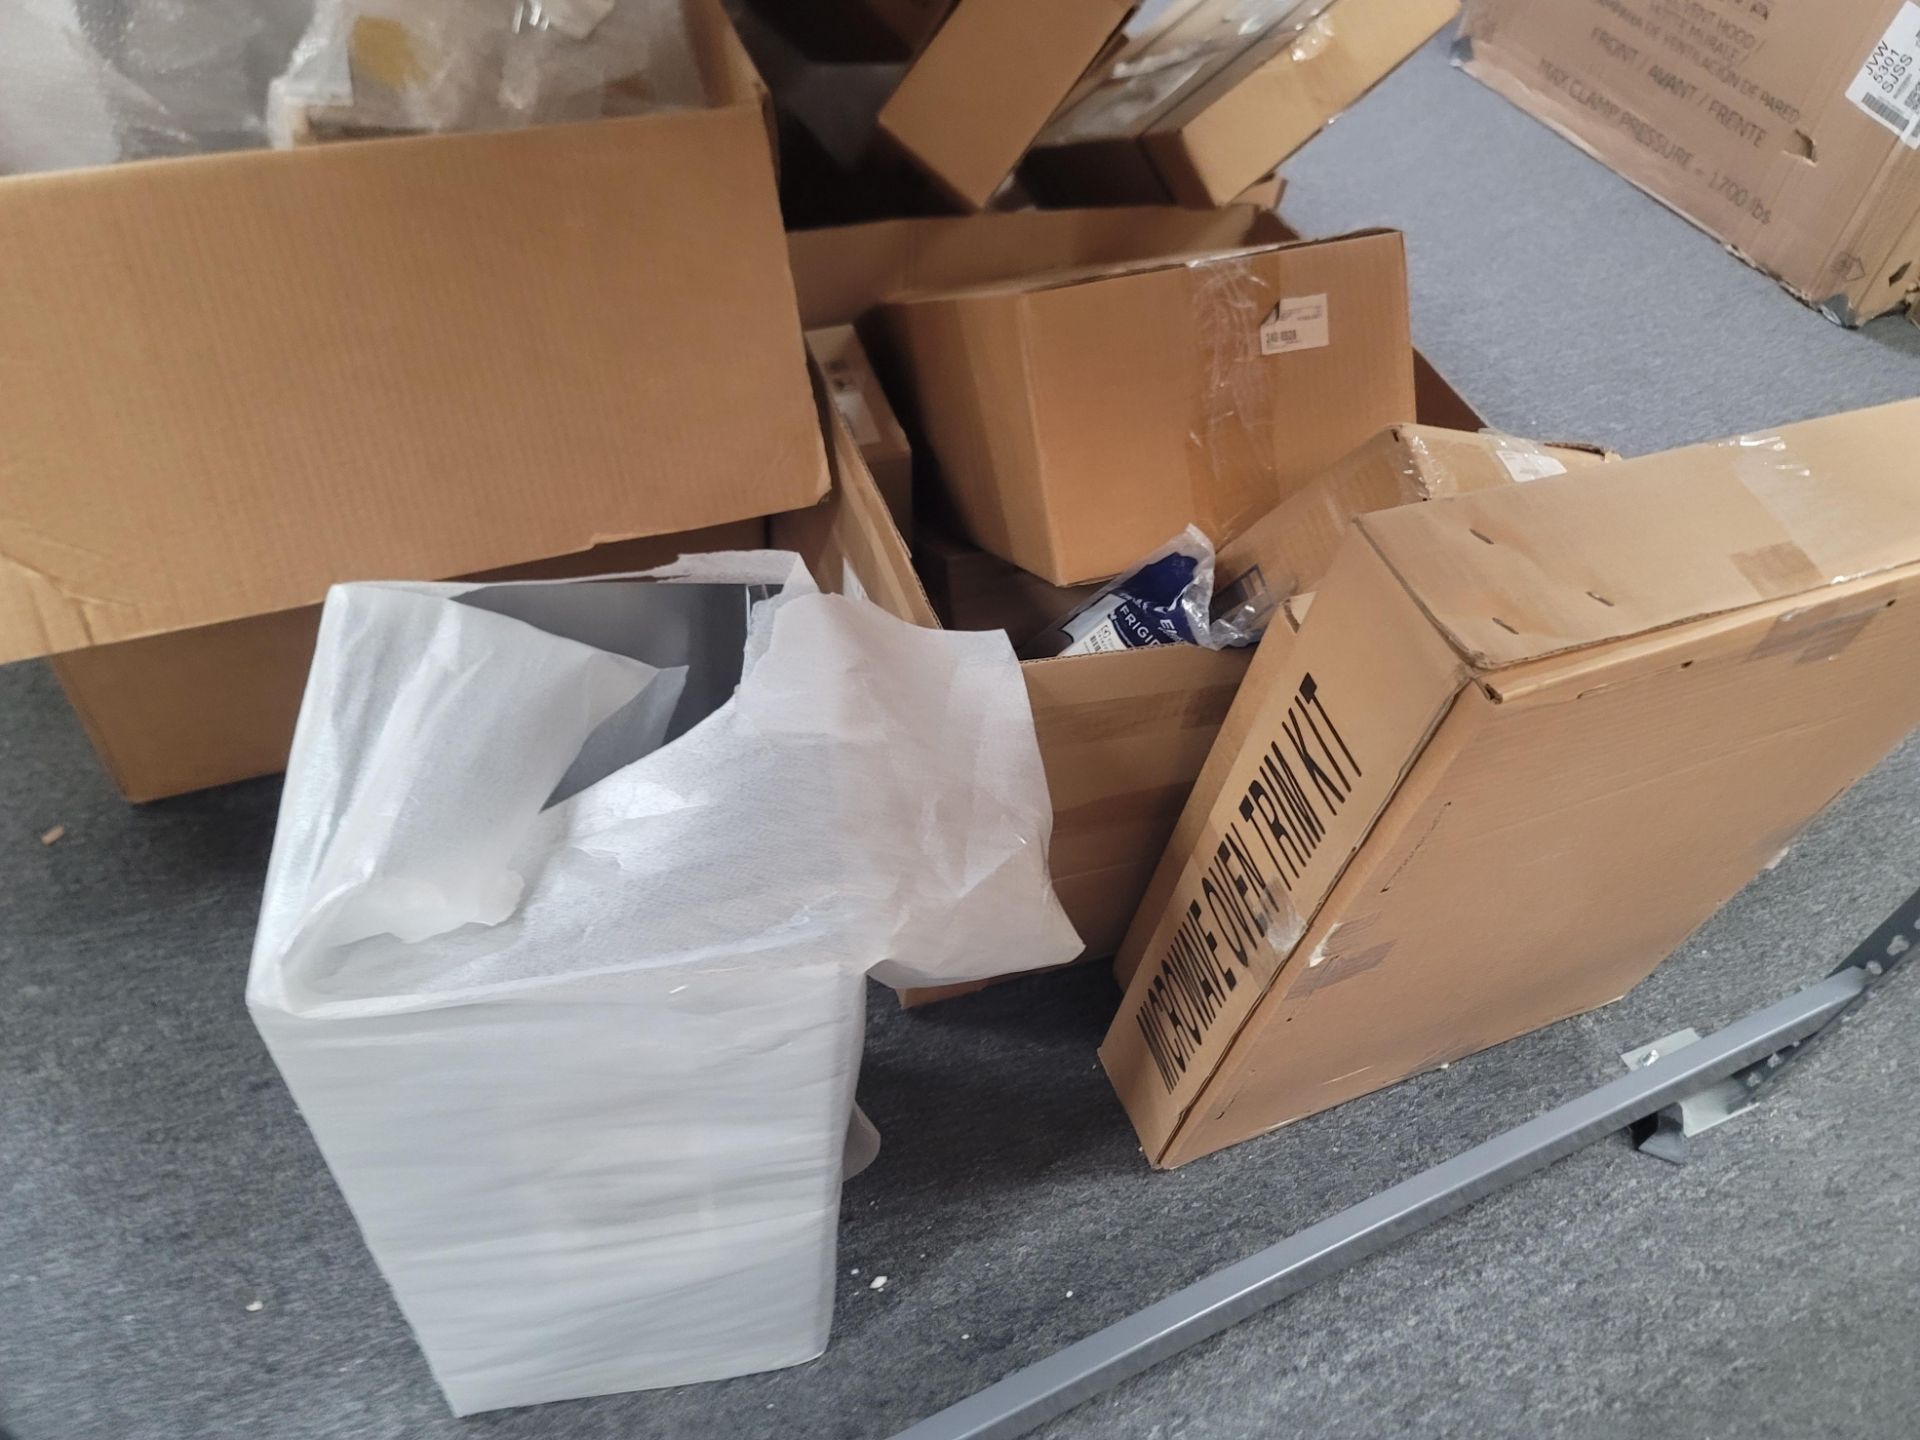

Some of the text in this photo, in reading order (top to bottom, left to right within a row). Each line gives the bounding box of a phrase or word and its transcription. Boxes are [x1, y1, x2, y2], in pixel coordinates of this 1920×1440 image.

[1865, 40, 1889, 76] JVW
[1873, 49, 1899, 84] 5301
[1881, 54, 1913, 93] SJSS
[1589, 27, 1638, 64] FRONT
[1648, 64, 1698, 101] AVANT
[1706, 98, 1768, 148] FRENTE
[1739, 79, 1759, 98] DE
[1758, 91, 1802, 125] PARED
[1569, 78, 1623, 121] CLAMP
[1618, 110, 1696, 169] PRESSURE
[1707, 171, 1751, 208] 1700
[1747, 196, 1774, 227] lbs
[1136, 671, 1362, 1095] MICROWAVE OVEN TRIM KIT
